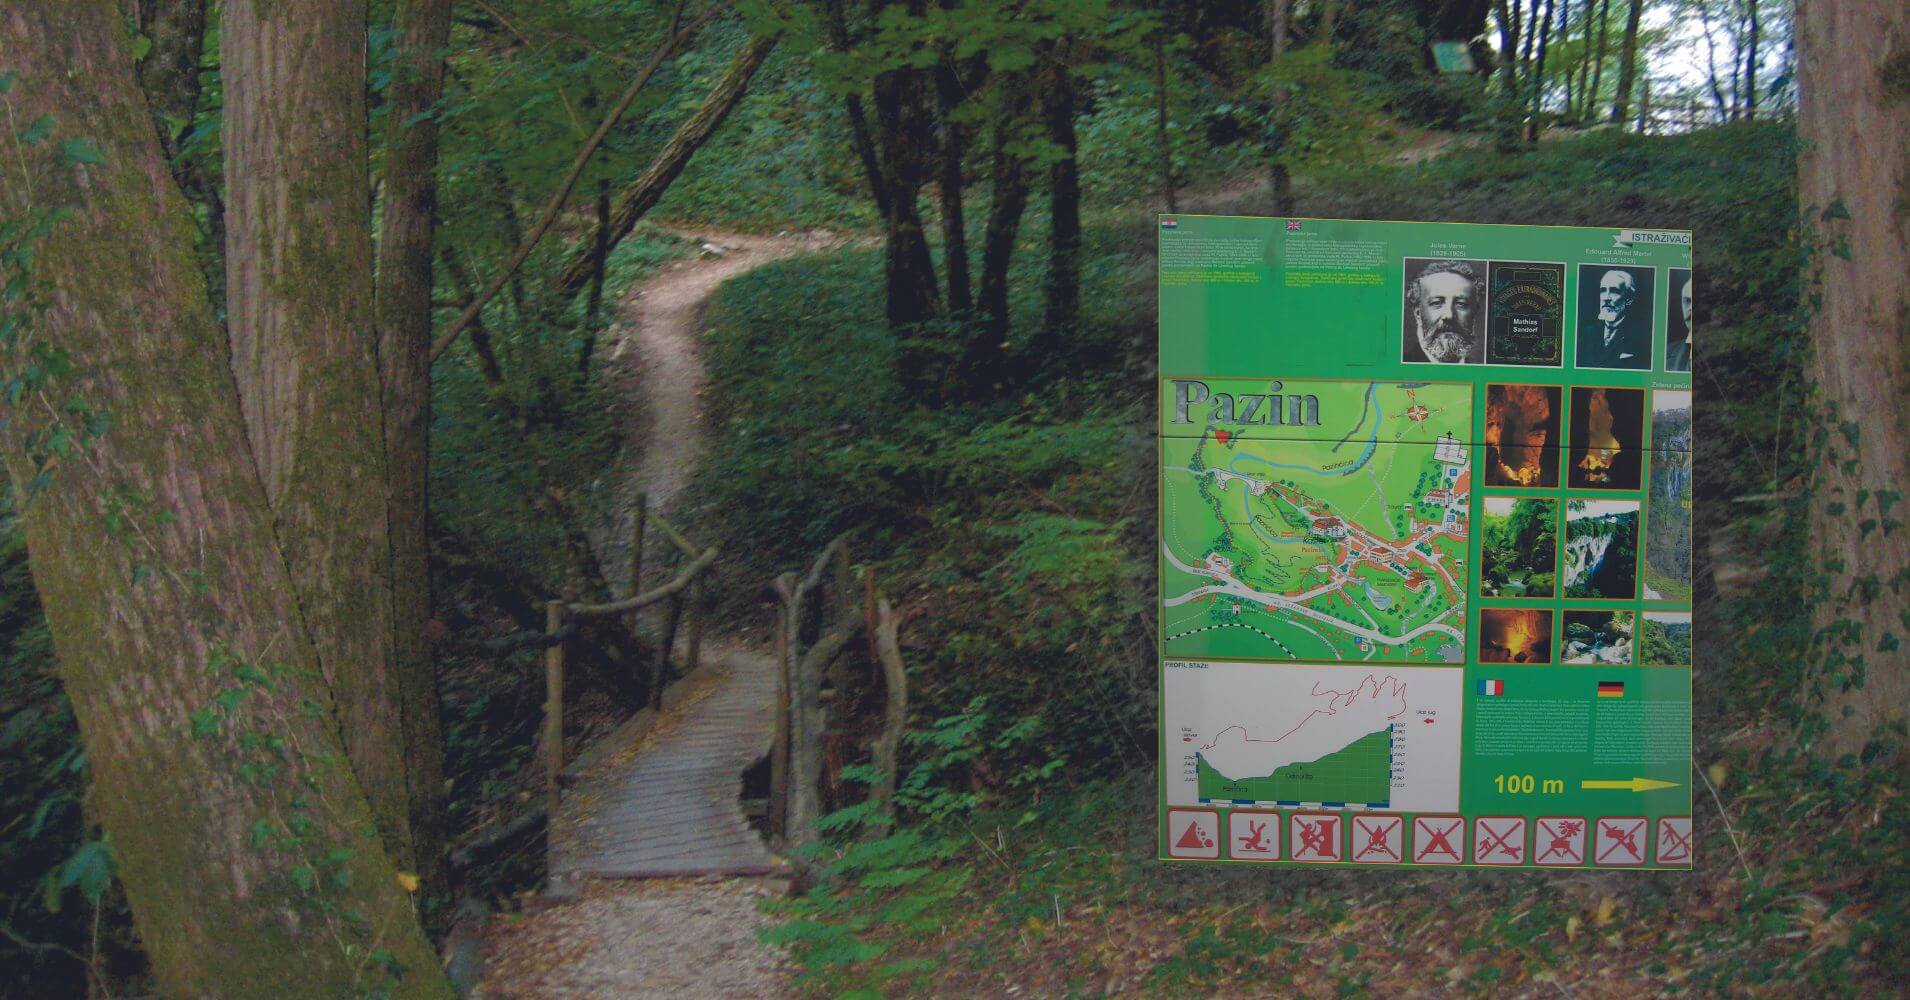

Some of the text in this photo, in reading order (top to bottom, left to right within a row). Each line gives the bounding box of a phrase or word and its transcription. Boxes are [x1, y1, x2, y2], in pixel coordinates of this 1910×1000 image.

[1513, 318, 1538, 326] Mathias
[1170, 380, 1321, 426] Pazin
[1165, 661, 1187, 669] PROFIL
[1494, 774, 1564, 794] 100 m
